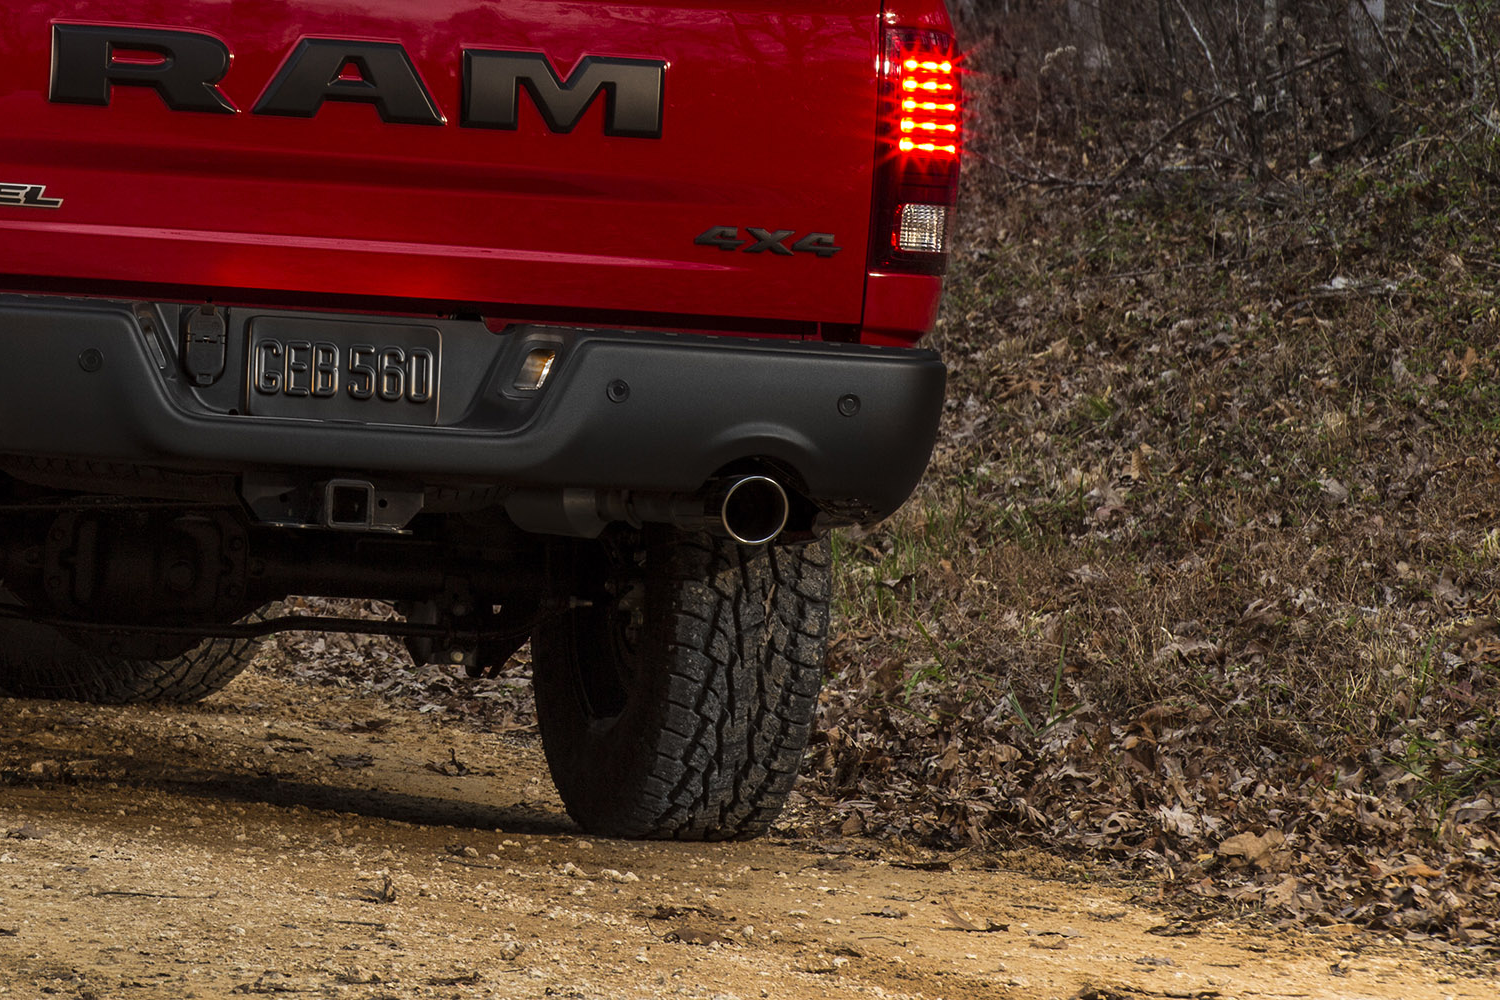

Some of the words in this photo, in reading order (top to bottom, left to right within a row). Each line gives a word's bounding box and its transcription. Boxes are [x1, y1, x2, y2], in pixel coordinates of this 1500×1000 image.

[49, 20, 668, 138] RAM
[255, 338, 339, 397] GEB
[348, 344, 433, 403] 560
